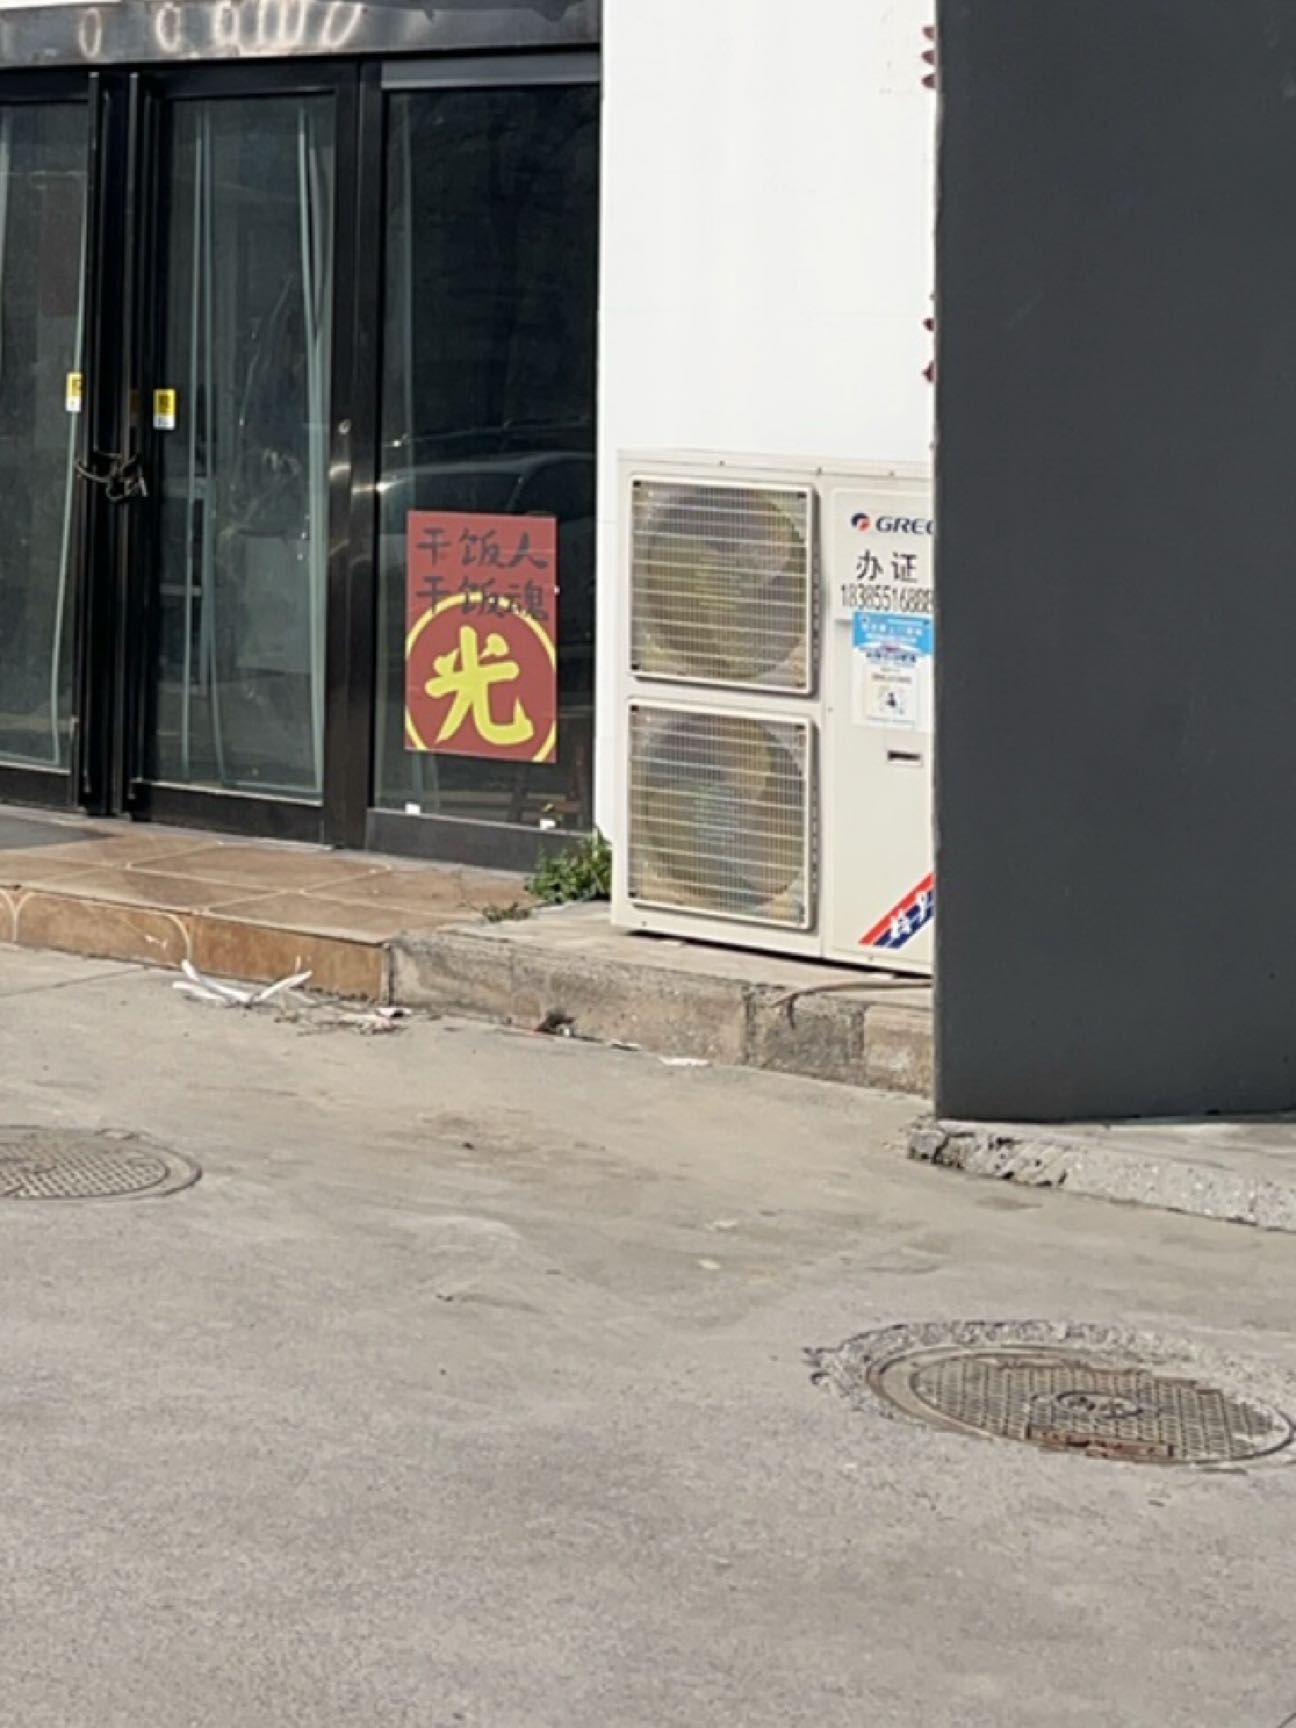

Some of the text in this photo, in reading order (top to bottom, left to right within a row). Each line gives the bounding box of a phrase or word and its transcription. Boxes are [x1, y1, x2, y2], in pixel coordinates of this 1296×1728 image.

[415, 526, 549, 570] 干饭人
[856, 548, 918, 583] 办证
[415, 575, 550, 623] 干饭魂
[424, 624, 535, 746] 光
